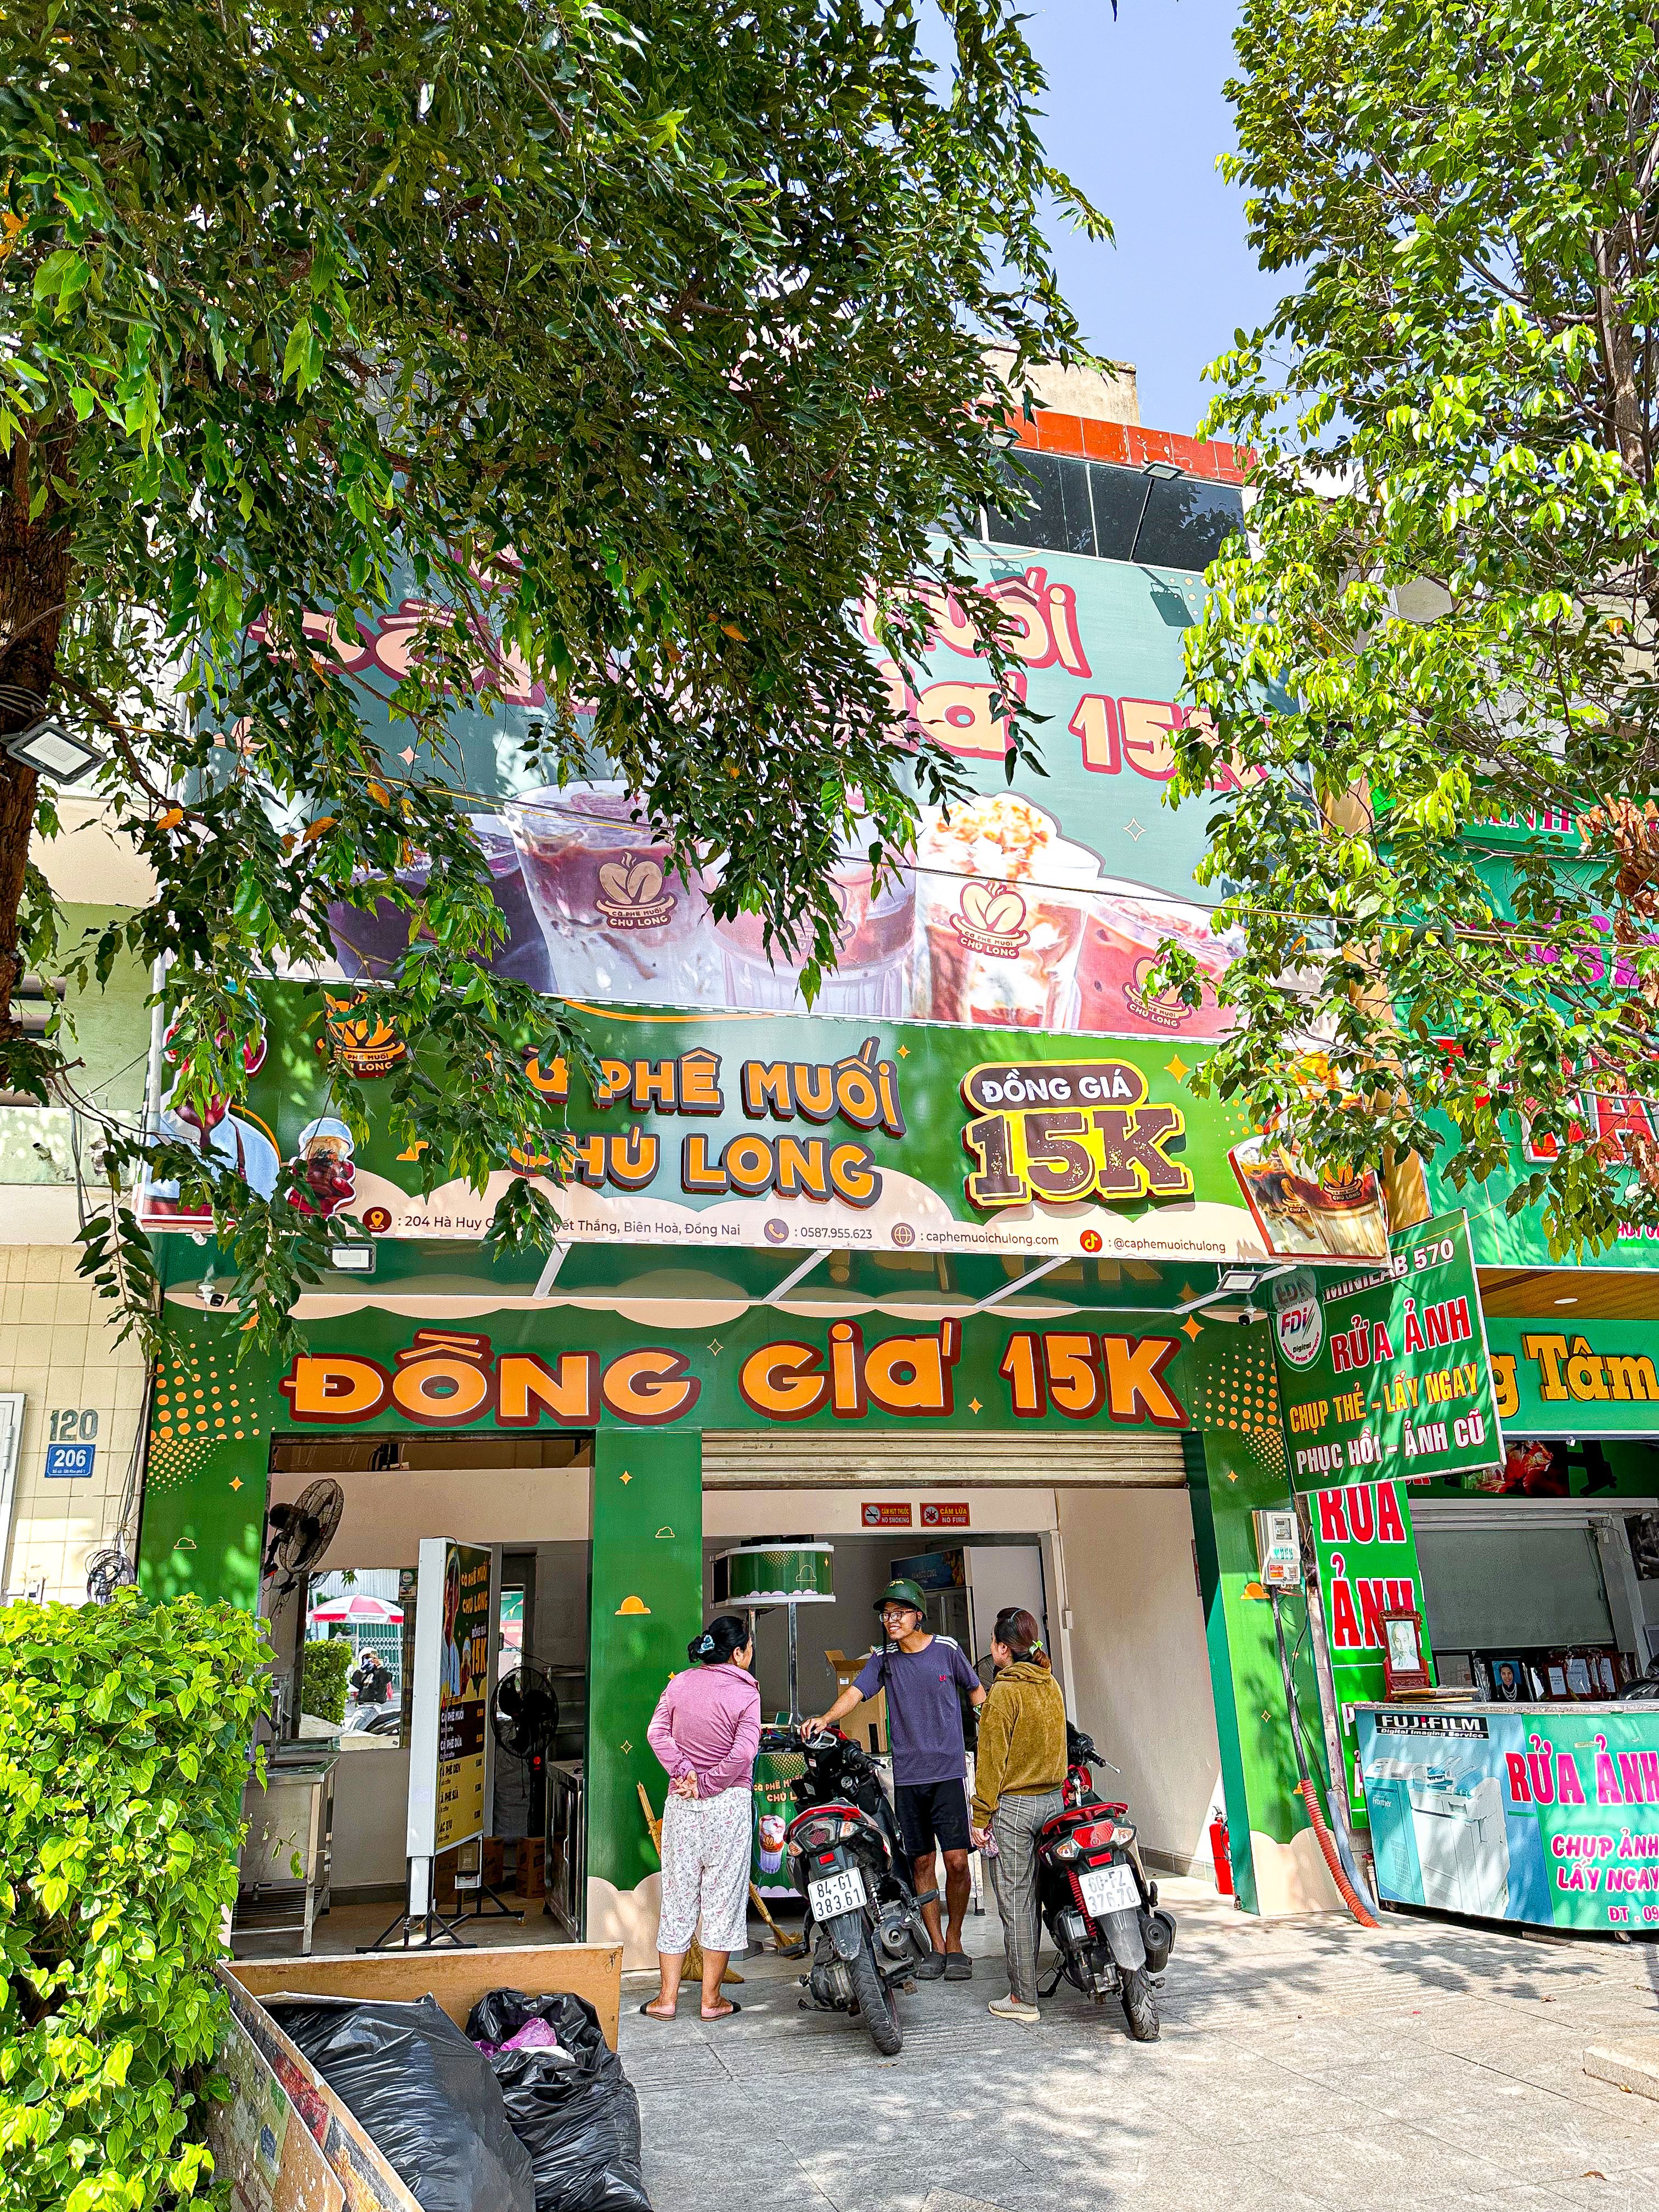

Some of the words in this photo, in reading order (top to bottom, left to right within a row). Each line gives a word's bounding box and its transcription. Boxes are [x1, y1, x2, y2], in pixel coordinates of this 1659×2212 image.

[637, 916, 668, 926] LONG
[986, 945, 1017, 957] LONG
[1151, 1014, 1178, 1027] LONG
[359, 1062, 394, 1071] LONG
[598, 1048, 723, 1108] PHÊ
[981, 1068, 1071, 1103] ĐỒNG
[1079, 1067, 1133, 1099] GIÁ
[969, 1106, 1188, 1200] 15K
[686, 1136, 879, 1203] LONG
[405, 1216, 430, 1227] 204
[435, 1215, 451, 1228] Hà
[456, 1217, 482, 1231] Huy
[578, 1218, 620, 1234] Thắng,
[624, 1221, 651, 1233] Biên
[656, 1222, 681, 1235] Hoà,
[685, 1222, 718, 1237] Đồng
[721, 1224, 741, 1235] Nai
[800, 1227, 872, 1239] 0587.955.623
[926, 1231, 1059, 1246] caphemuoichulong.com
[1114, 1238, 1226, 1254] @caphemuoichulong
[1413, 1237, 1454, 1270] 570
[1330, 1314, 1395, 1374] RỬA
[1403, 1295, 1474, 1356] ẢNH
[281, 1330, 693, 1420] ĐỒNG
[1000, 1333, 1183, 1421] 15K
[1522, 1333, 1659, 1401] Tâm
[1289, 1400, 1329, 1435] CHỤP
[1333, 1380, 1367, 1424] THẺ
[1383, 1370, 1419, 1414] LẤY
[1424, 1362, 1478, 1405] NGAY
[49, 1409, 99, 1441] 120
[1295, 1442, 1344, 1477] PHỤC
[1347, 1426, 1383, 1466] HỒI
[1403, 1418, 1449, 1458] ẢNH
[1454, 1407, 1486, 1448] CŨ
[54, 1449, 87, 1467] 206
[473, 1590, 488, 1612] LONG
[471, 1638, 487, 1675] 15K
[1381, 1715, 1481, 1731] FUJIFILM
[1410, 1729, 1446, 1737] Imaging
[1504, 1733, 1587, 1805] RỬA
[1594, 1733, 1659, 1806] ẢNH
[767, 1792, 787, 1802] CHÚ
[1551, 1835, 1615, 1862] CHỤP
[1618, 1826, 1659, 1859] ẢNH
[817, 1873, 852, 1898] 84-G1
[1557, 1860, 1601, 1893] LẤY
[1606, 1867, 1659, 1893] NGAY
[816, 1888, 861, 1917] 383.61
[1088, 1886, 1136, 1912] 376.70
[1607, 1906, 1629, 1923] ĐT
